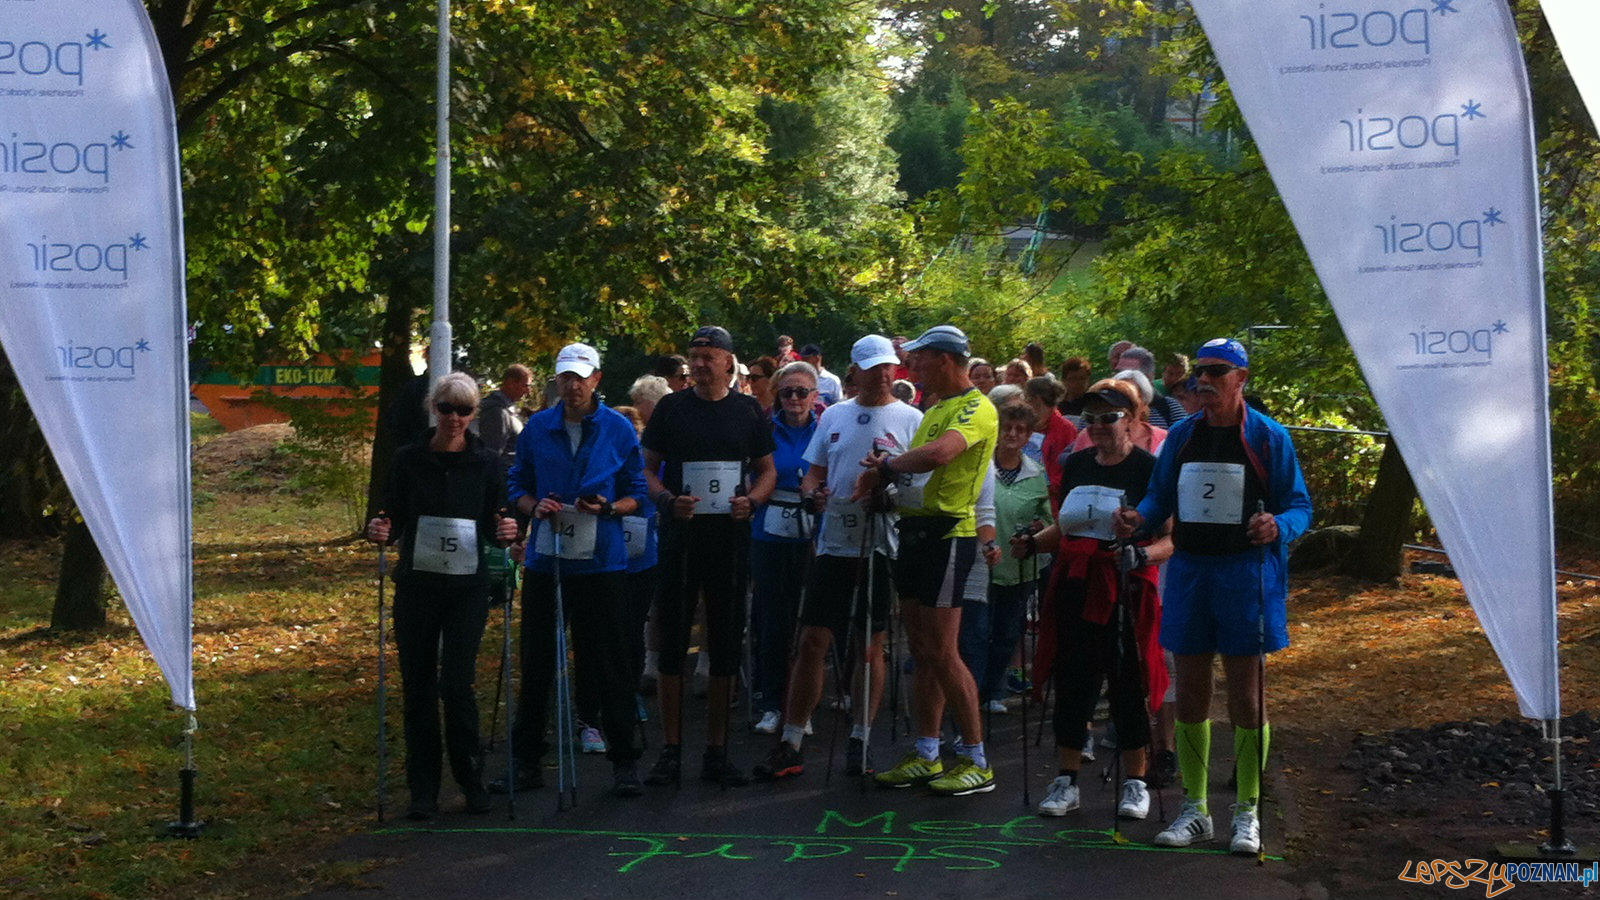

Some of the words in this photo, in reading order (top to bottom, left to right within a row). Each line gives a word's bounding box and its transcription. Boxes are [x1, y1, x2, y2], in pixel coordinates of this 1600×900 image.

[708, 479, 721, 494] 8
[1202, 483, 1216, 500] 2
[1086, 504, 1093, 519] 1
[842, 513, 857, 528] 13
[440, 536, 458, 553] 15
